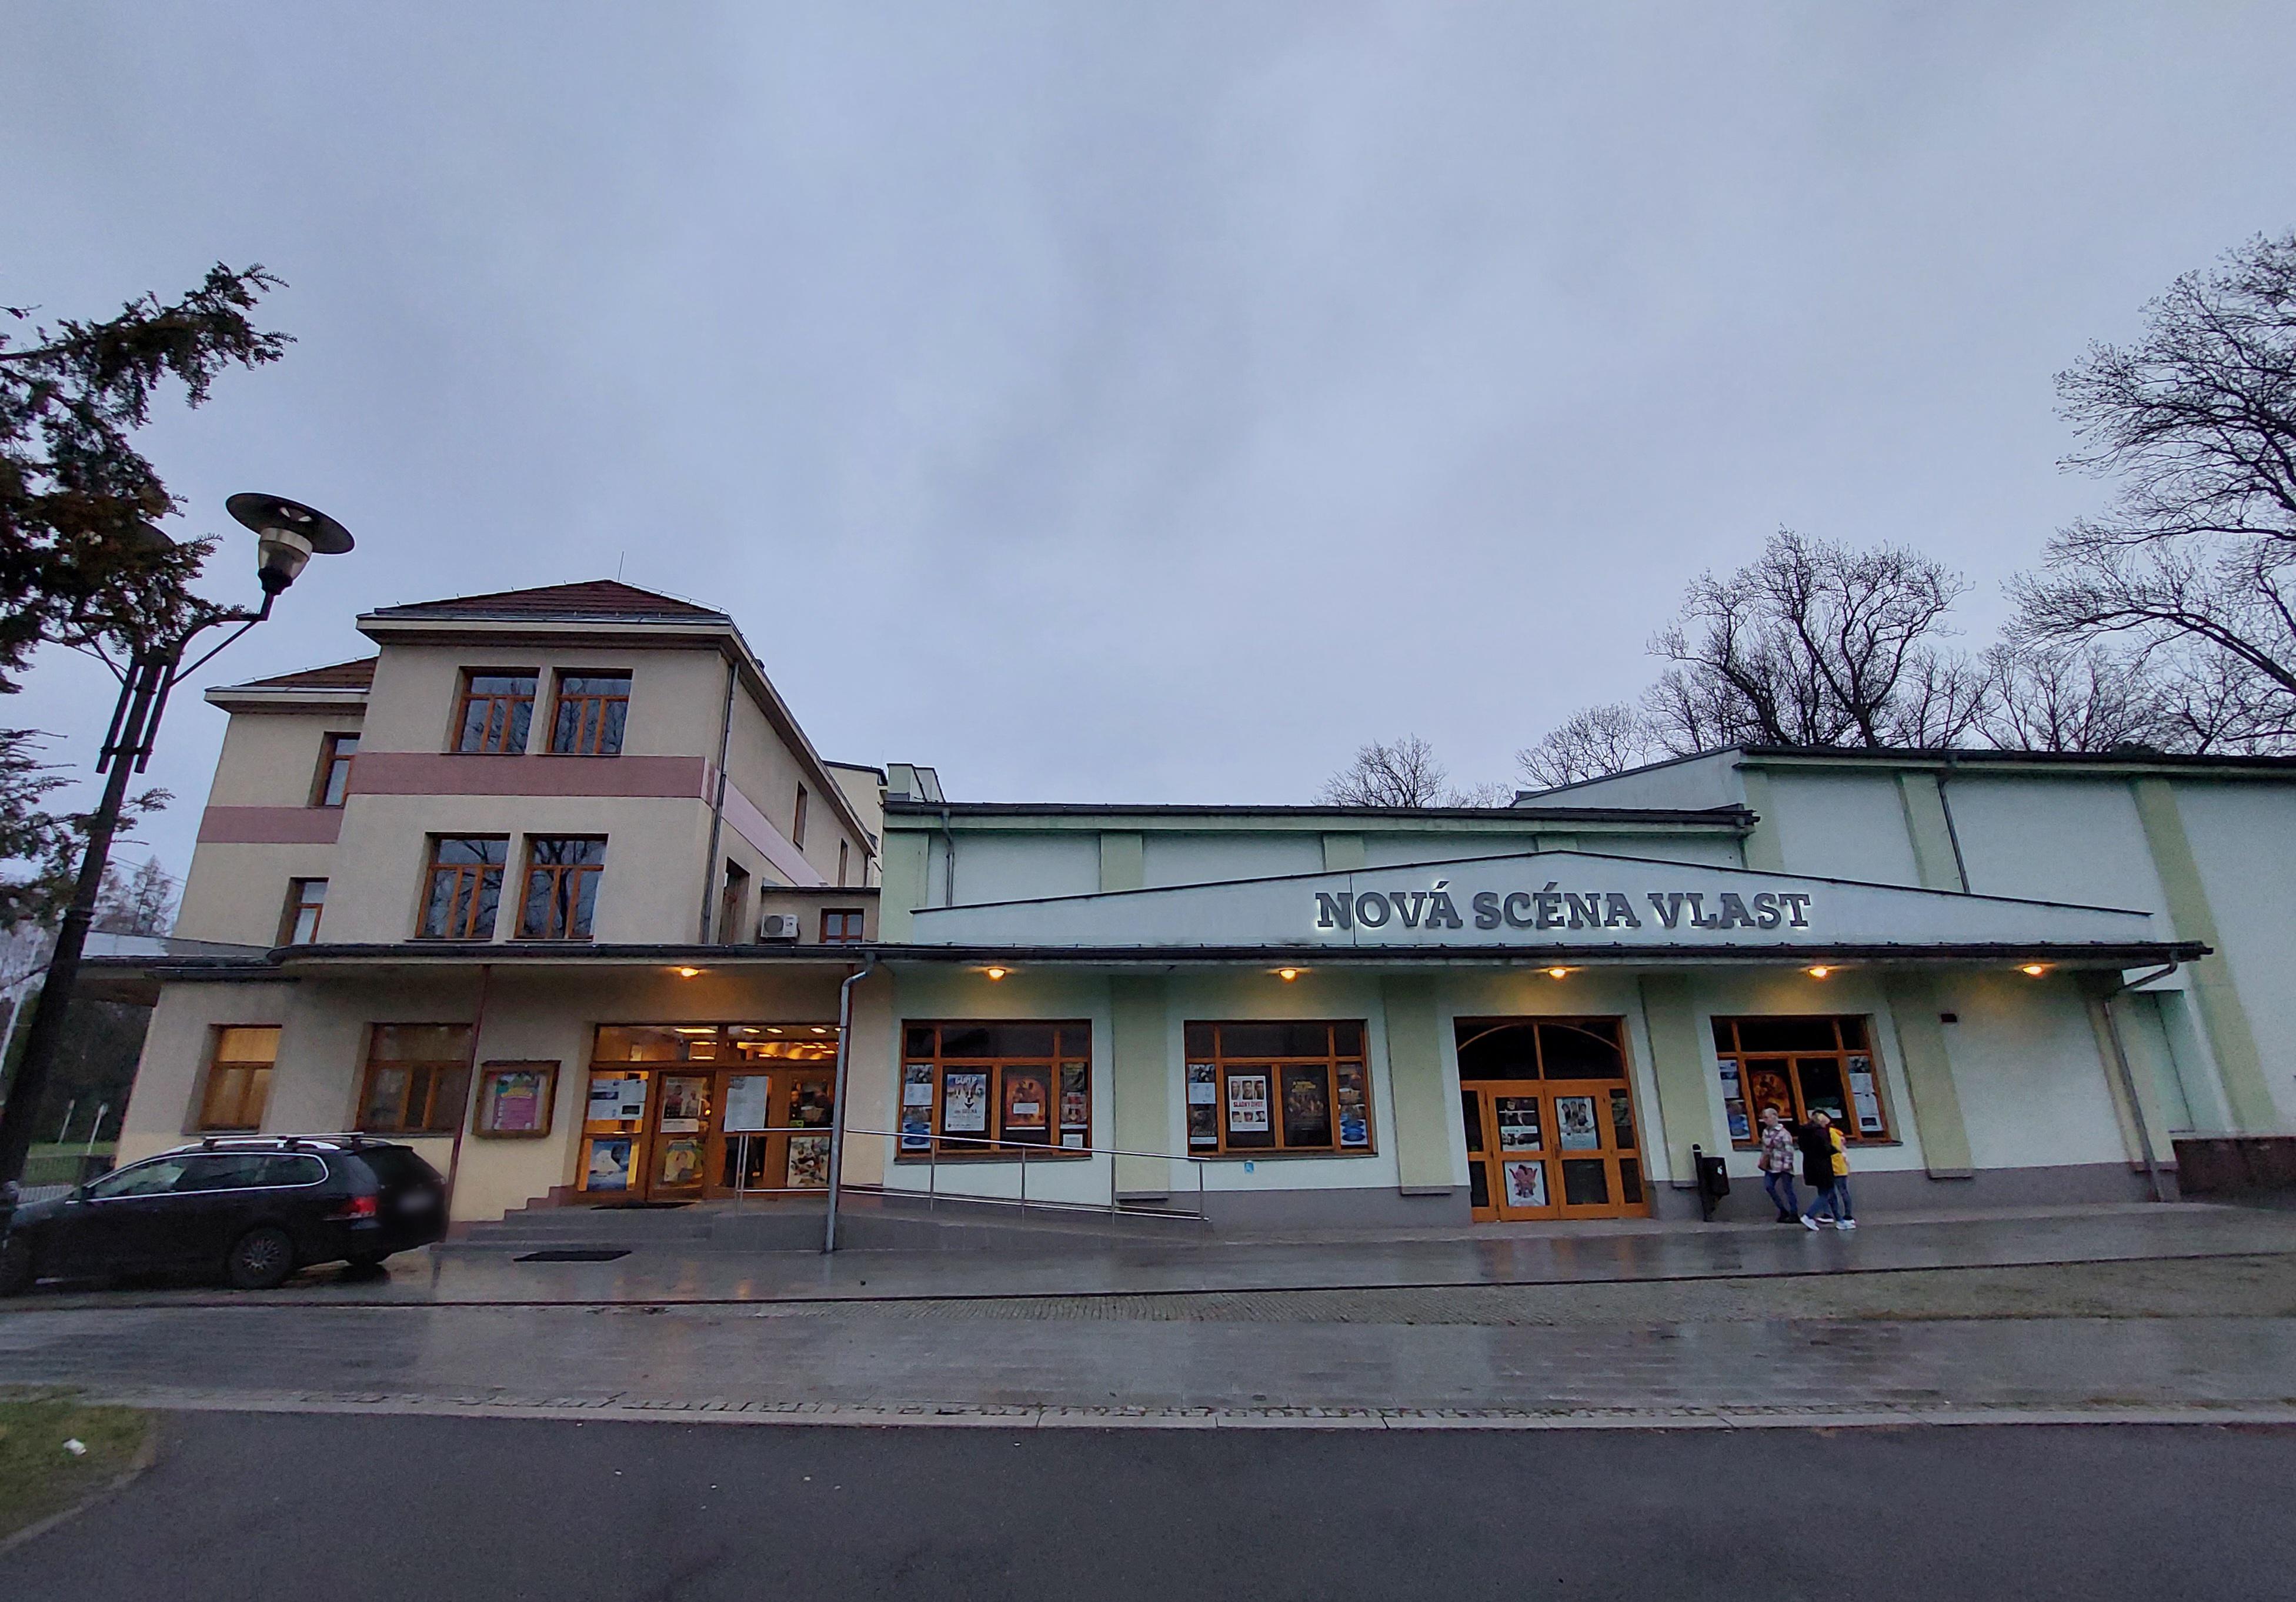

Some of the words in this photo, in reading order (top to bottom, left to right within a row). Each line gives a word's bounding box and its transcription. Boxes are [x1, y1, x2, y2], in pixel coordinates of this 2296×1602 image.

[1315, 880, 1463, 929] NOVÁ
[1473, 881, 1641, 929] SCÉNA
[1647, 892, 1811, 929] VLAST
